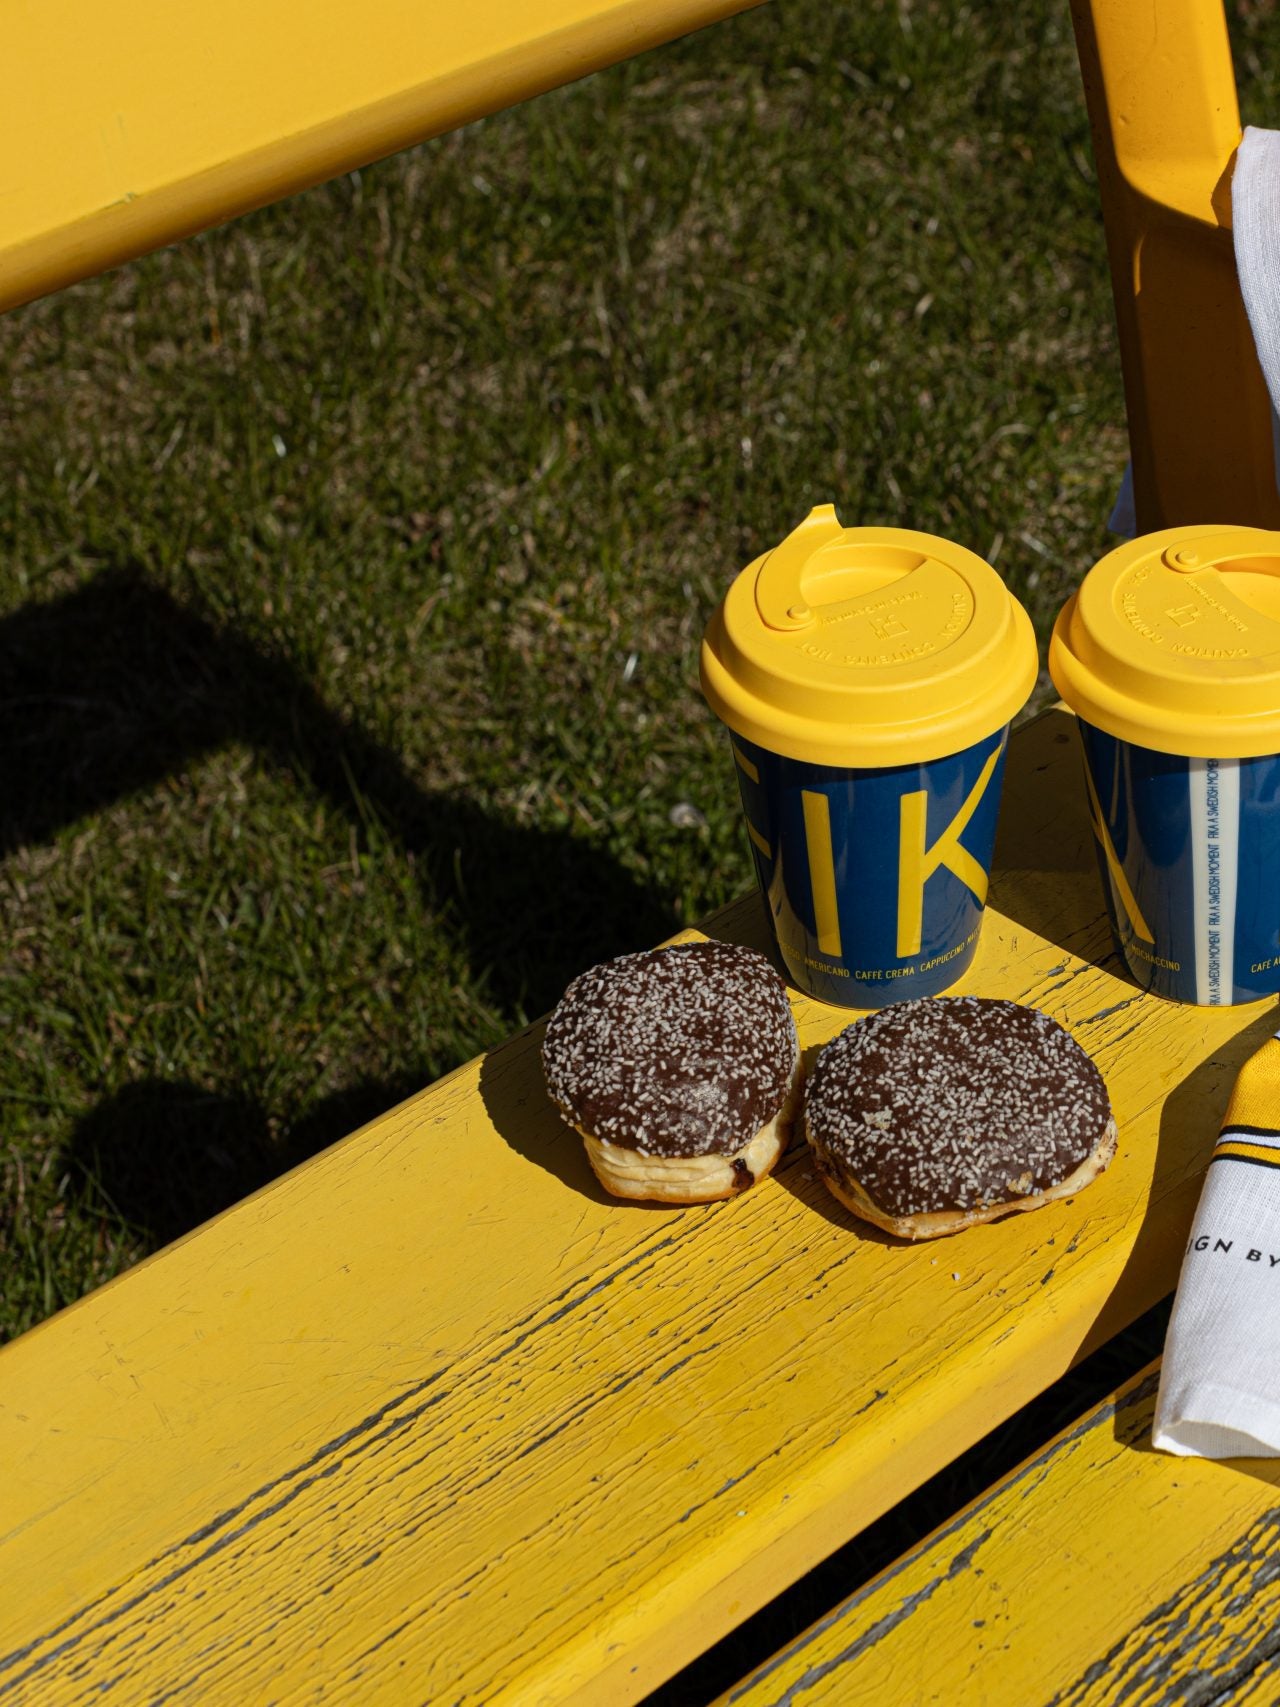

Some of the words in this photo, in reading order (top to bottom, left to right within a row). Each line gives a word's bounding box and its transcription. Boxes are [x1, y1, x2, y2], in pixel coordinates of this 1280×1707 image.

[1207, 786, 1219, 817] SWEDISH
[1208, 843, 1220, 875] MOMENT
[1208, 876, 1220, 905] SWEDISH
[804, 957, 850, 978] AMERICANO
[886, 967, 915, 979] CREMA
[920, 941, 966, 973] CAPPUCCINO
[1209, 930, 1220, 960] MOMENT
[1209, 960, 1220, 987] SWEDISH
